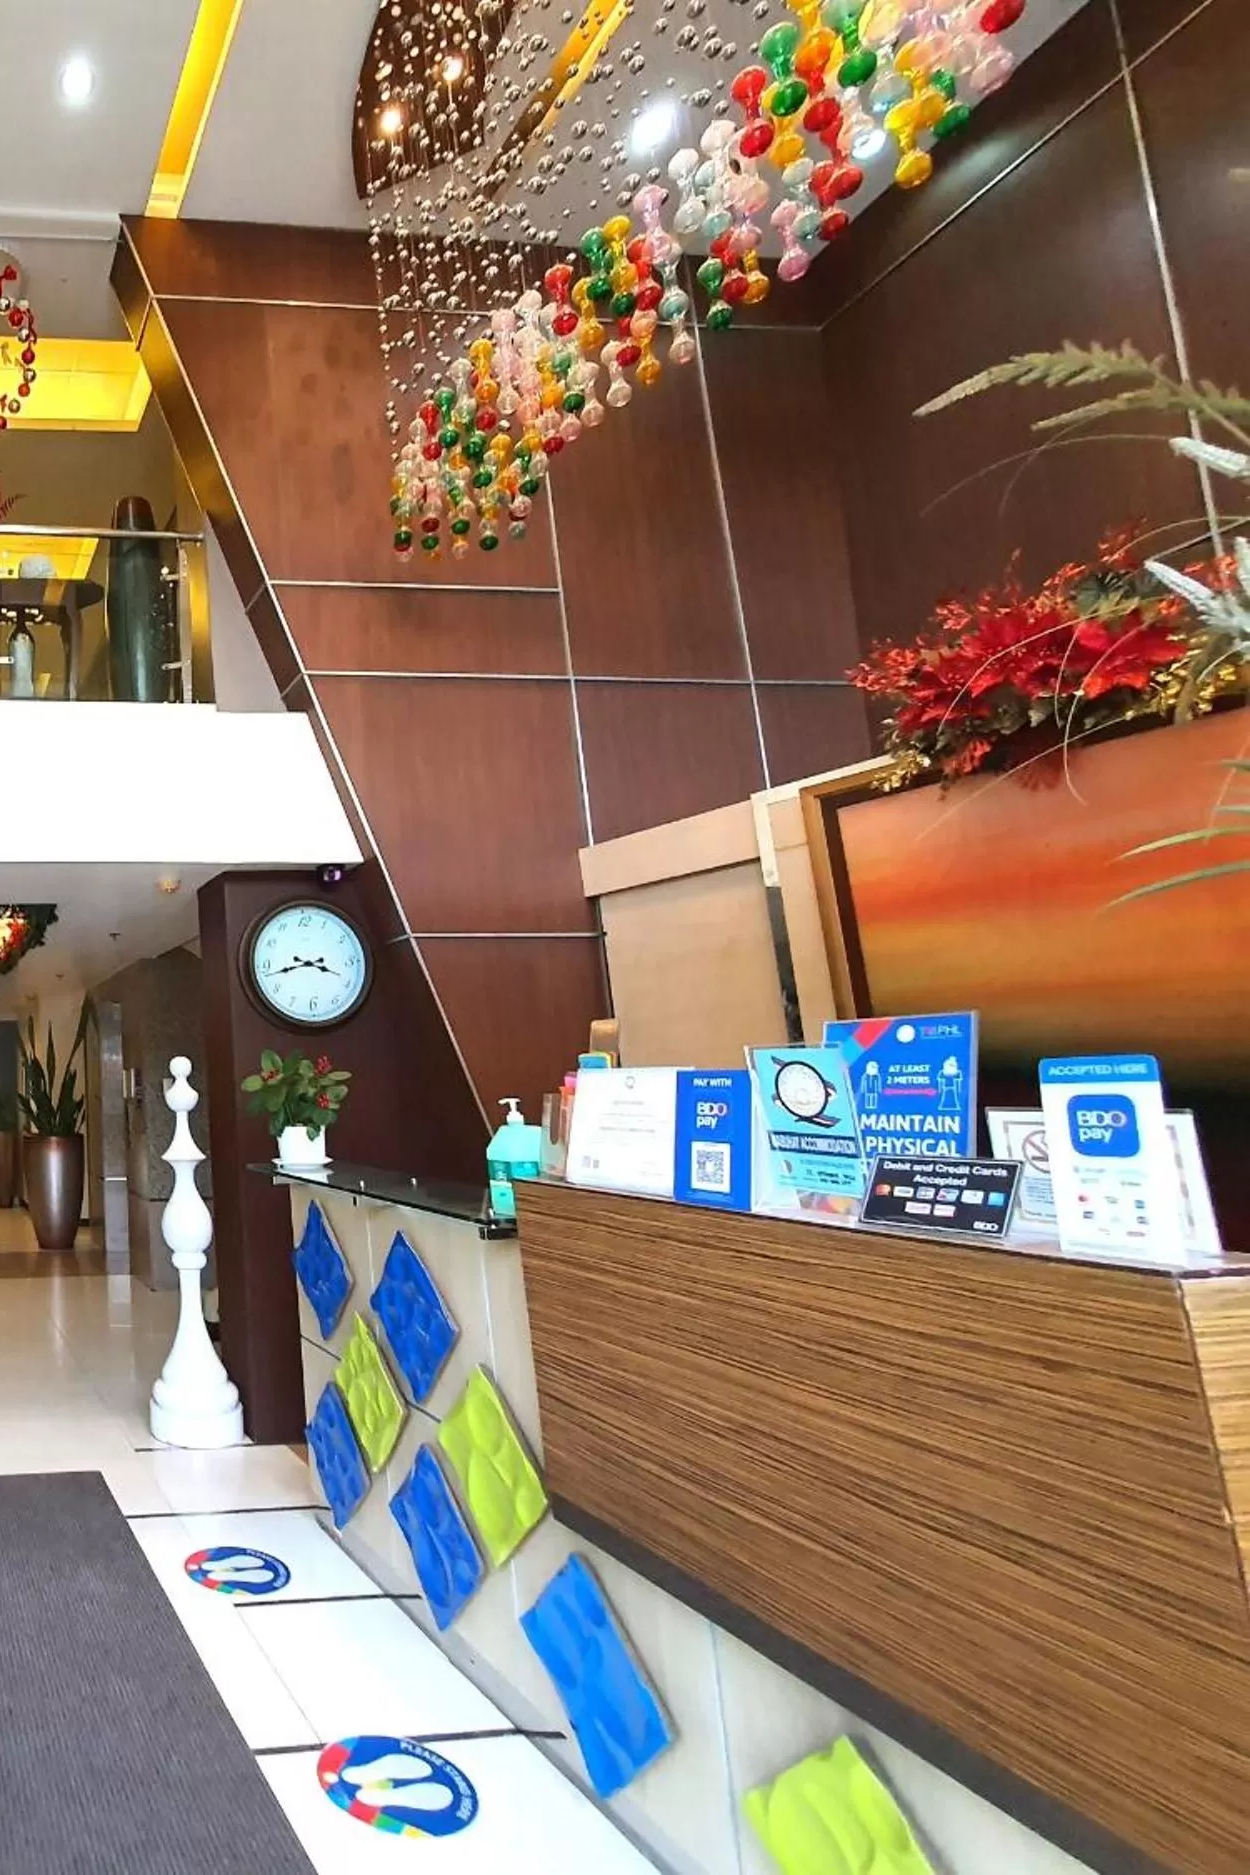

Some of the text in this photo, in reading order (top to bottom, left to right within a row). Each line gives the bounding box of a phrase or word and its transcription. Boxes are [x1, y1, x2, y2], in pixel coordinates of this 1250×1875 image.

[888, 1064, 931, 1073] AT LEAST
[1048, 1062, 1148, 1076] ACCEPTED HERE
[693, 1077, 732, 1087] PAY WITH
[893, 1076, 931, 1085] METERS
[696, 1101, 727, 1117] BDO
[696, 1116, 718, 1129] pay
[859, 1114, 961, 1134] MAINTAIN
[1076, 1109, 1127, 1127] BDO
[1078, 1128, 1113, 1144] pay
[865, 1136, 962, 1158] PHYSICAL
[883, 1160, 911, 1171] Debit
[913, 1163, 933, 1172] and
[935, 1164, 970, 1175] Credit
[972, 1166, 1008, 1177] Cards
[913, 1174, 968, 1187] Accepted
